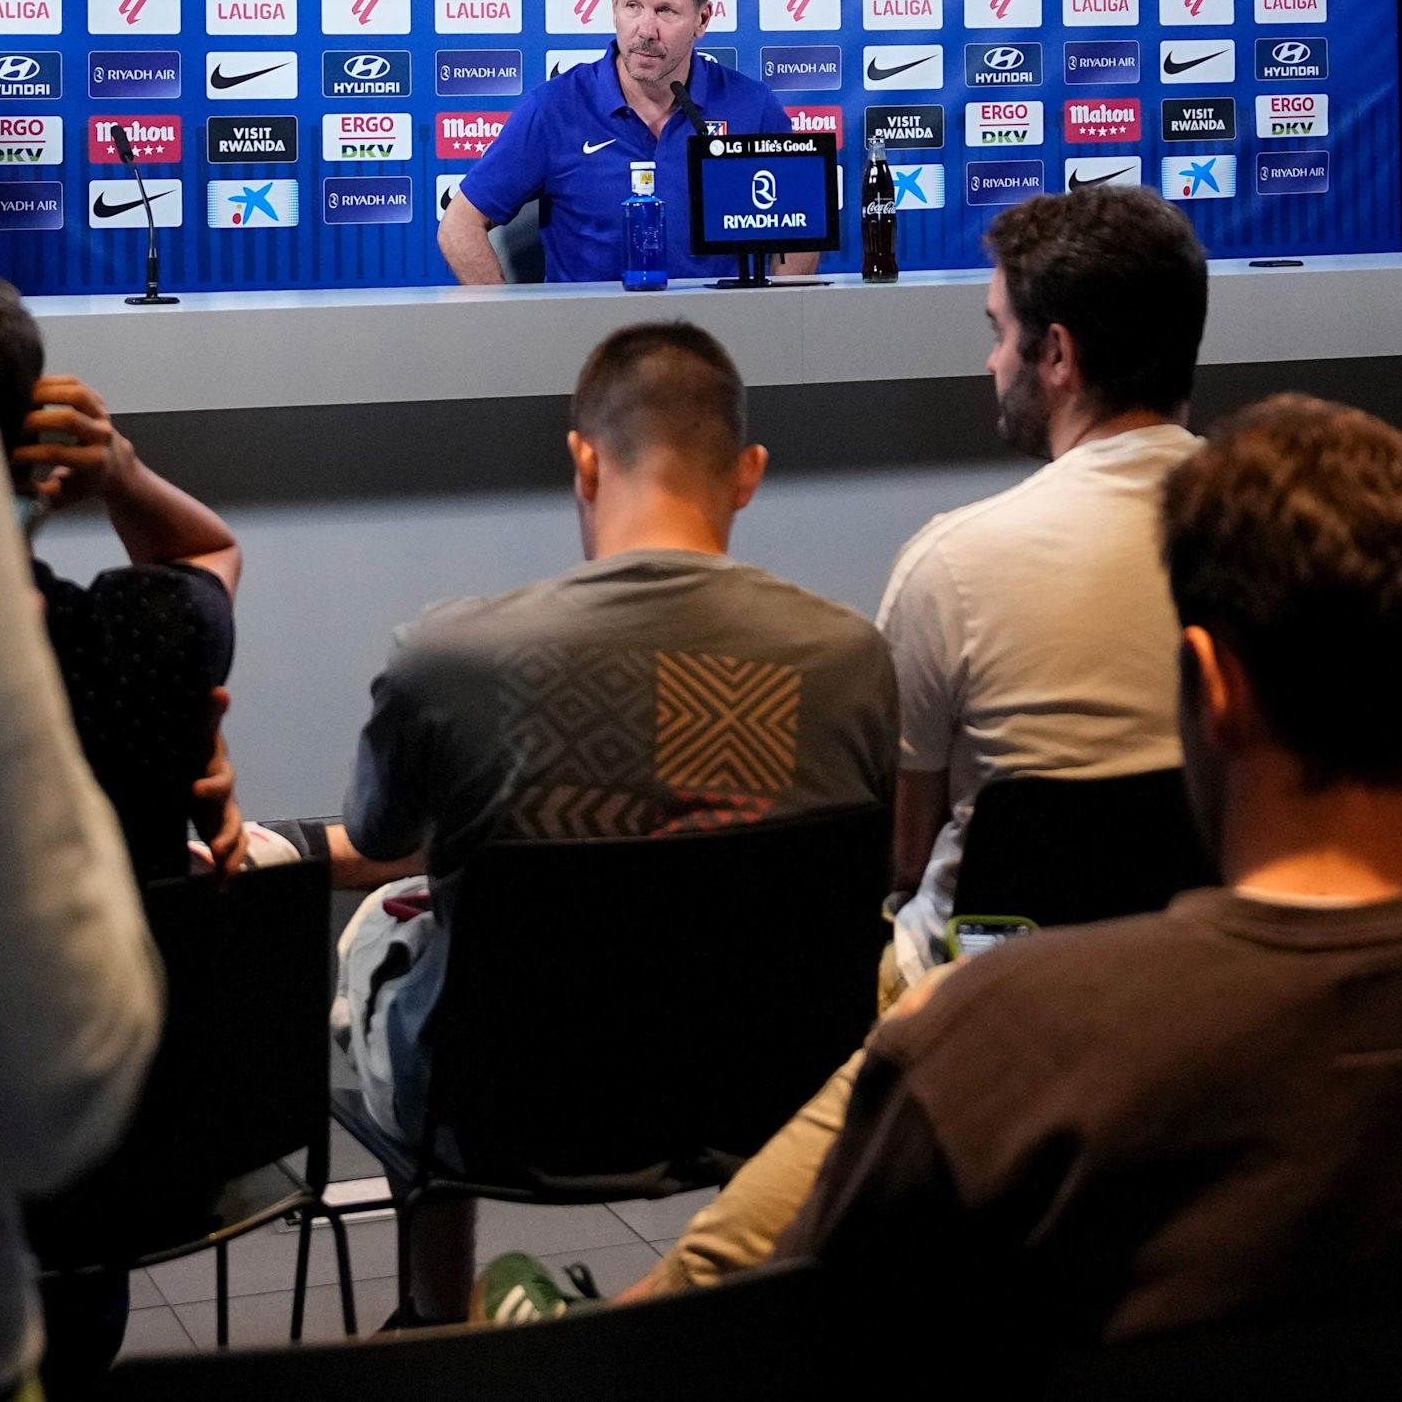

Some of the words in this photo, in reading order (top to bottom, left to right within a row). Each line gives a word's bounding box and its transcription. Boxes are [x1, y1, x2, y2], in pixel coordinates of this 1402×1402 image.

[218, 3, 285, 20] LALIGA
[446, 2, 511, 19] LALIGA
[777, 63, 817, 74] RIYADH
[818, 63, 837, 73] AIR
[1079, 57, 1117, 68] RIYADH
[1117, 57, 1135, 67] AIR
[107, 69, 153, 80] RIYADH
[154, 69, 175, 80] AIR
[975, 72, 1033, 83] HYUNDAI
[1264, 66, 1319, 77] HYUNDAI
[1271, 96, 1315, 112] ERGO
[1069, 104, 1136, 124] Mahou
[1182, 108, 1214, 120] VISIT
[341, 116, 394, 133] ERGO
[442, 117, 505, 138] Maho
[1171, 119, 1226, 132] RWANDA
[1271, 121, 1314, 136] DKV
[233, 127, 272, 140] VISIT
[219, 139, 286, 153] RWANDA
[341, 144, 394, 158] DKV
[726, 141, 743, 154] LG
[754, 140, 782, 153] Life's
[783, 139, 817, 152] Good.
[1271, 167, 1308, 178] RIYADH
[1308, 167, 1325, 177] AIR
[342, 194, 385, 206] RIYADH
[387, 194, 407, 205] AIR
[723, 214, 778, 229] RIYADH
[781, 213, 807, 228] AIR
